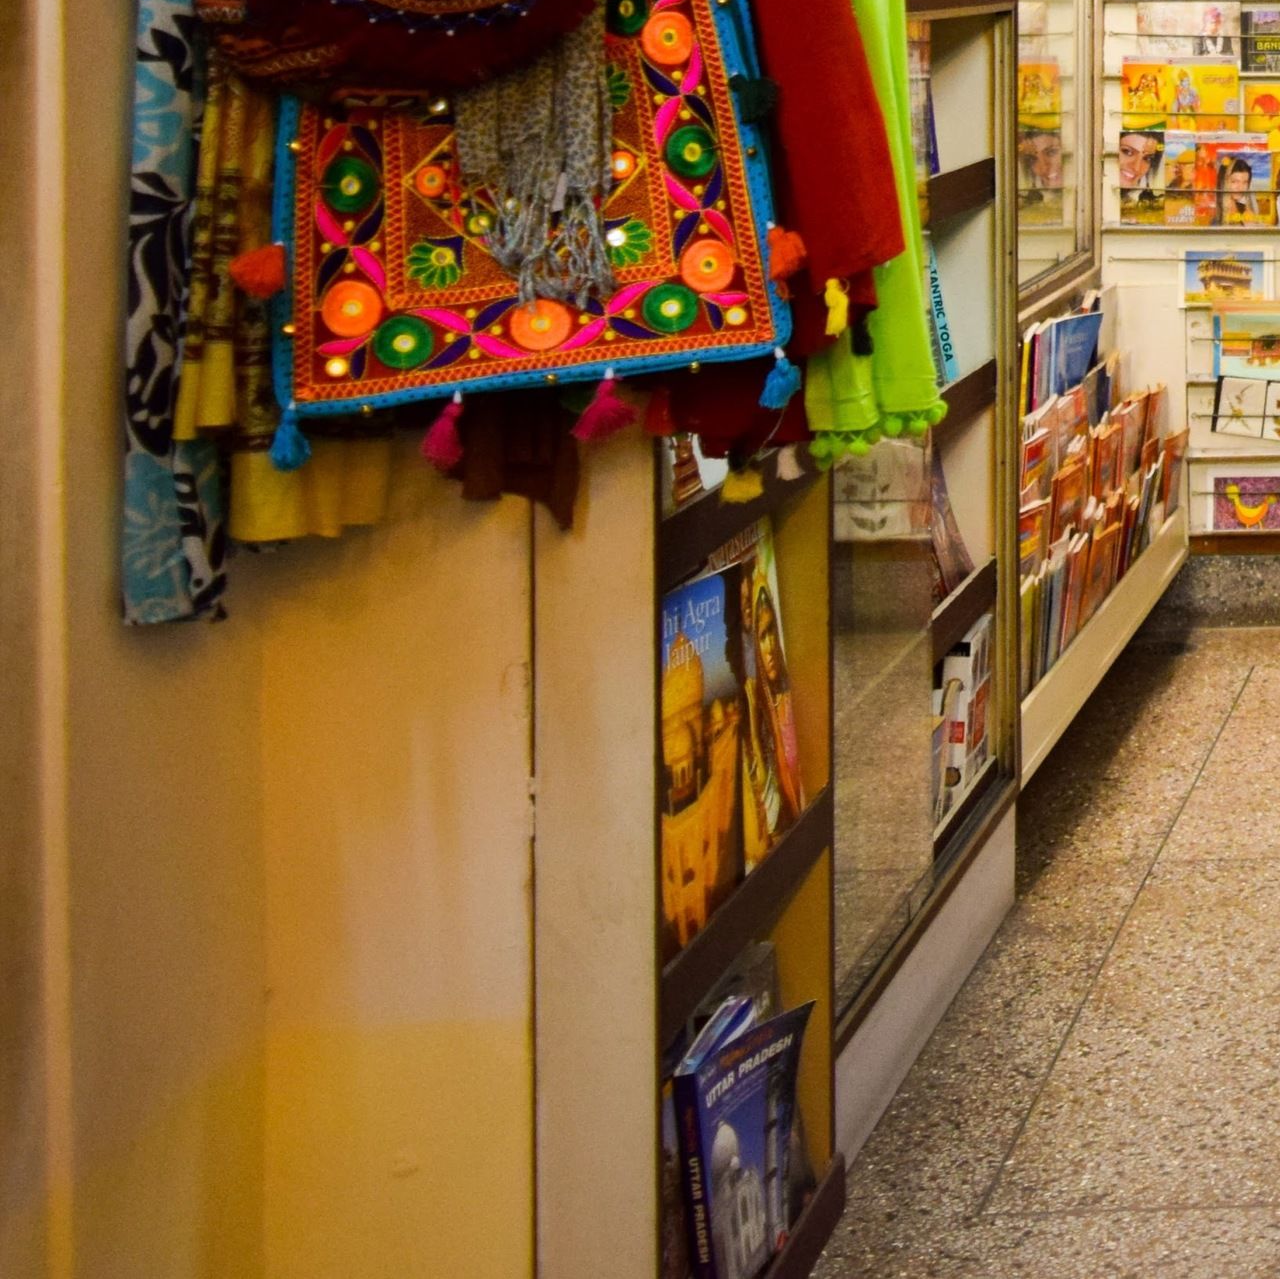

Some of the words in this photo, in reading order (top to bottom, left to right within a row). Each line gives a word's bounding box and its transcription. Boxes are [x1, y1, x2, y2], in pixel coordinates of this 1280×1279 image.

[930, 269, 946, 320] TANTRIC
[938, 322, 954, 363] YOGA
[683, 594, 721, 632] Agra
[665, 631, 713, 673] Jaipur
[705, 1070, 735, 1109] UTTAR
[737, 1032, 794, 1079] PRADESH
[687, 1156, 704, 1200] UTTAR
[693, 1205, 711, 1265] PRADESH
